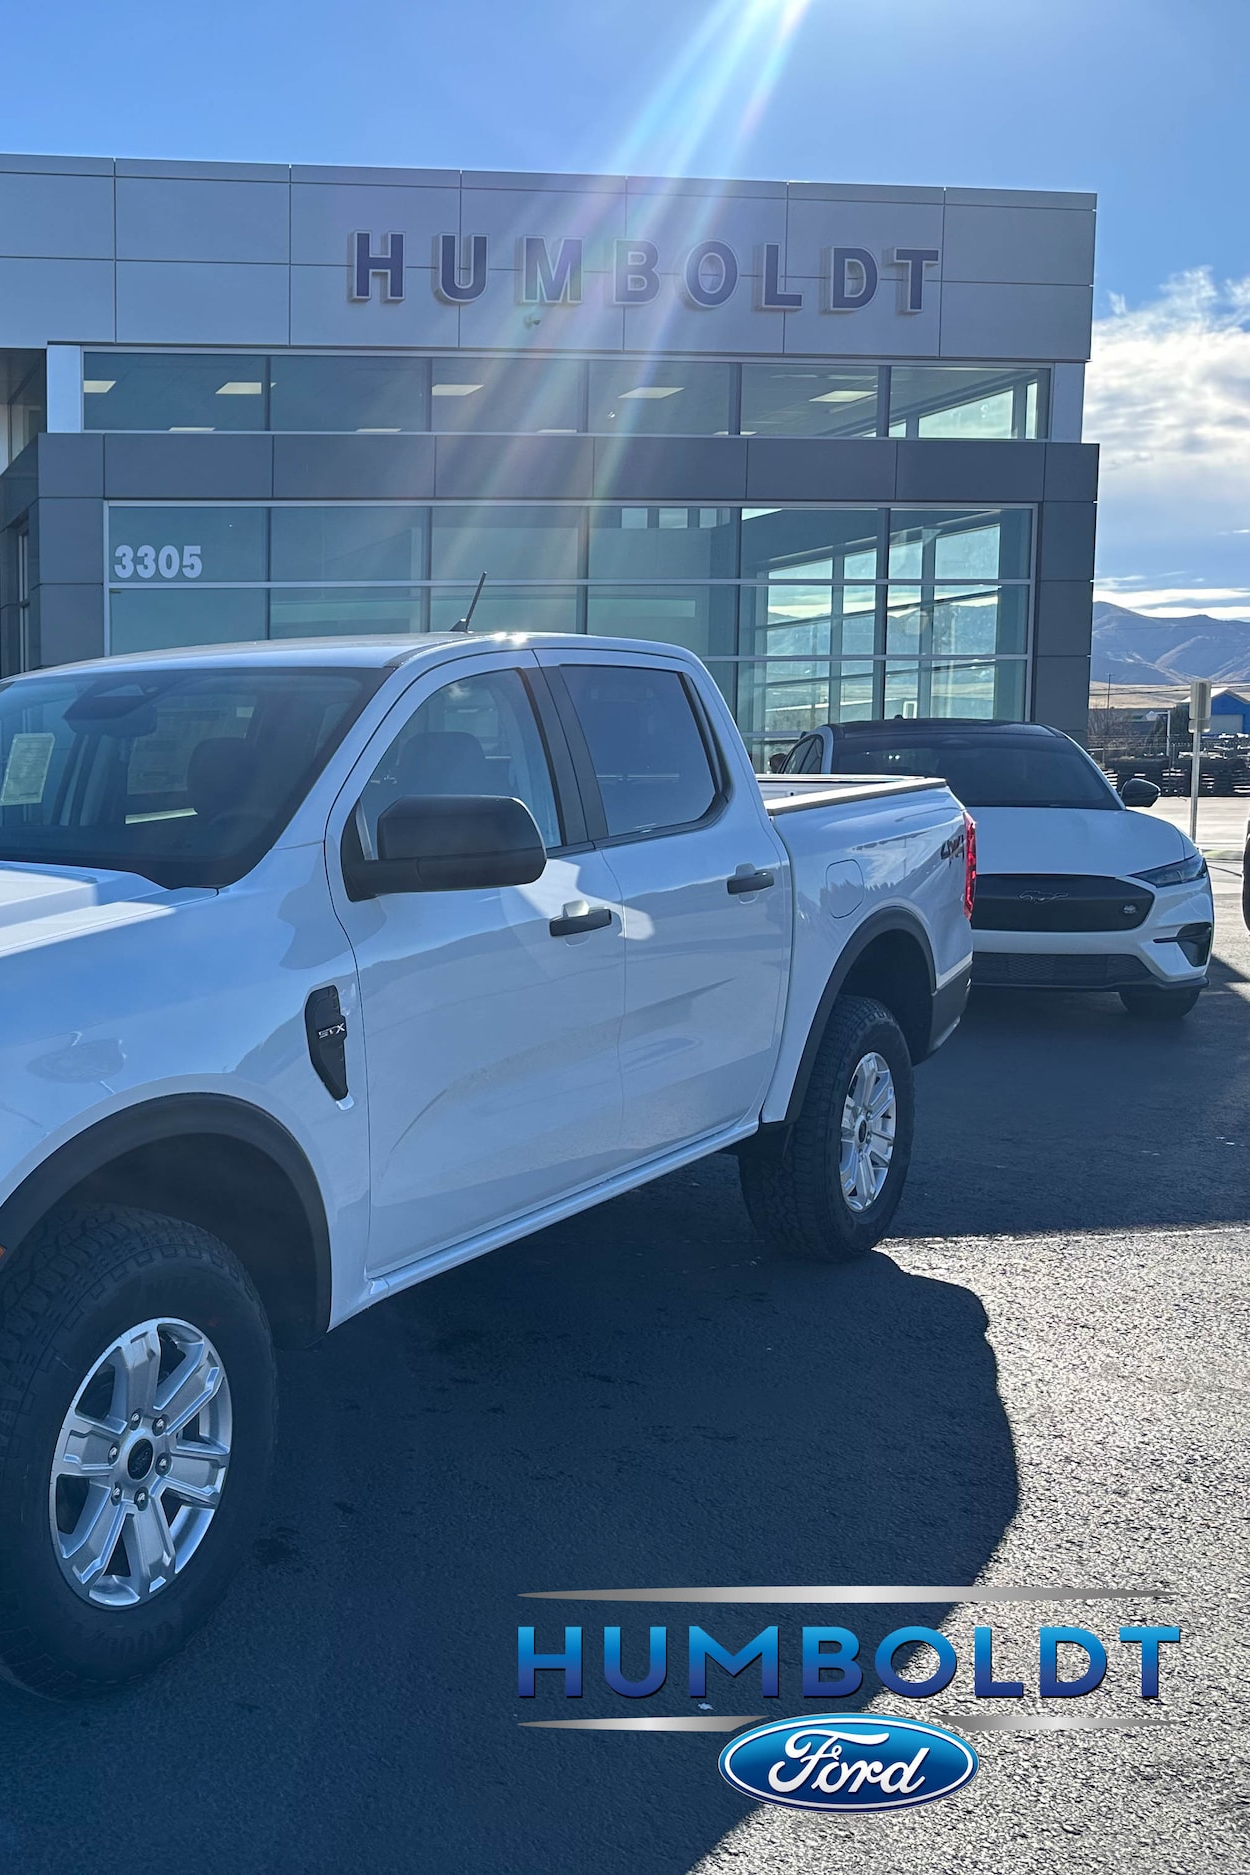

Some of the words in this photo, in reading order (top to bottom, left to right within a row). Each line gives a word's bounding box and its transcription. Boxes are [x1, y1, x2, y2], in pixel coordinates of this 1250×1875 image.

[352, 231, 940, 313] HUMBOLDT
[114, 545, 202, 578] 3305
[318, 1023, 345, 1039] STX
